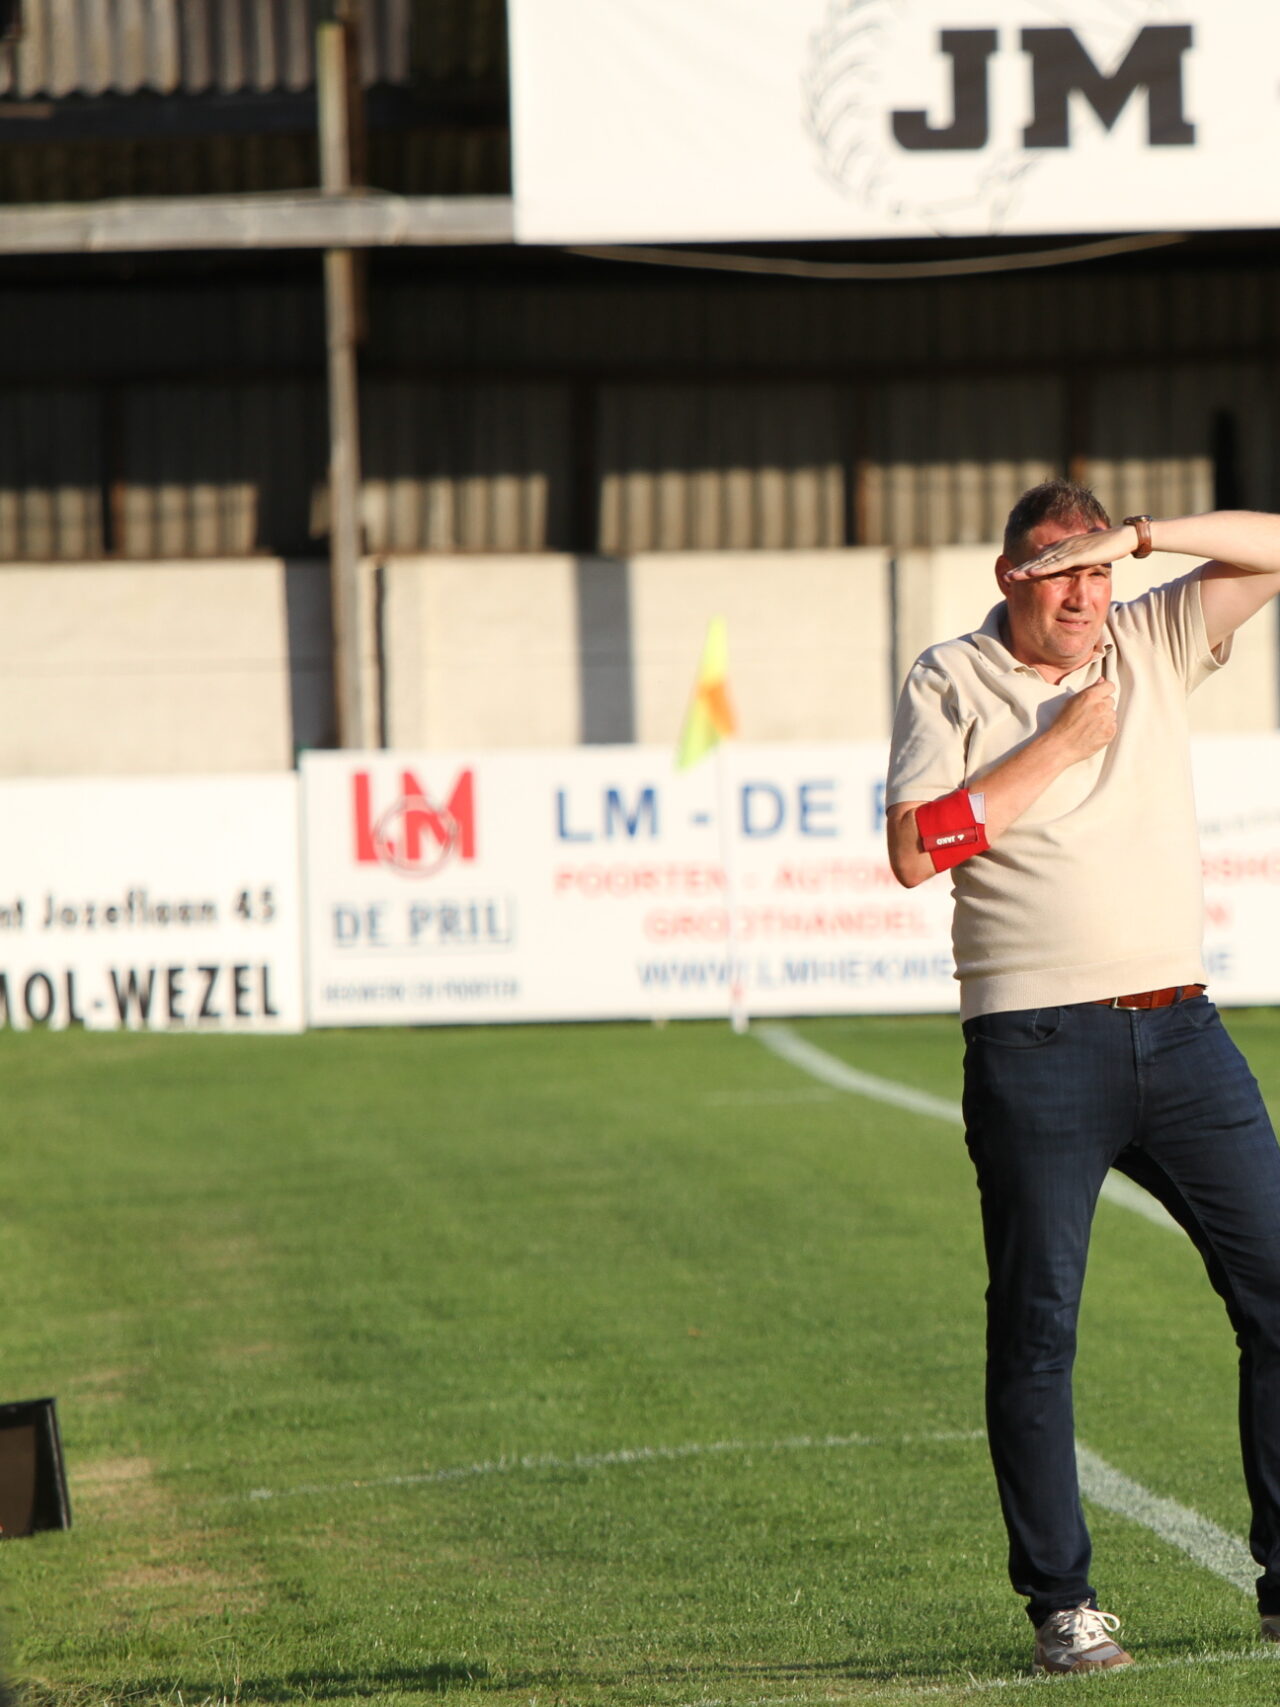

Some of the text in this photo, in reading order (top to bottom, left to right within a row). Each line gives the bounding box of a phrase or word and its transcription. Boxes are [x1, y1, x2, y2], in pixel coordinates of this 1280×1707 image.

[891, 24, 1198, 150] JM
[556, 785, 660, 842] LM
[739, 781, 838, 837] DE
[554, 860, 729, 896] POORTEN
[43, 887, 218, 930] Jozeflaan
[235, 888, 277, 924] 45
[332, 901, 390, 948] DE
